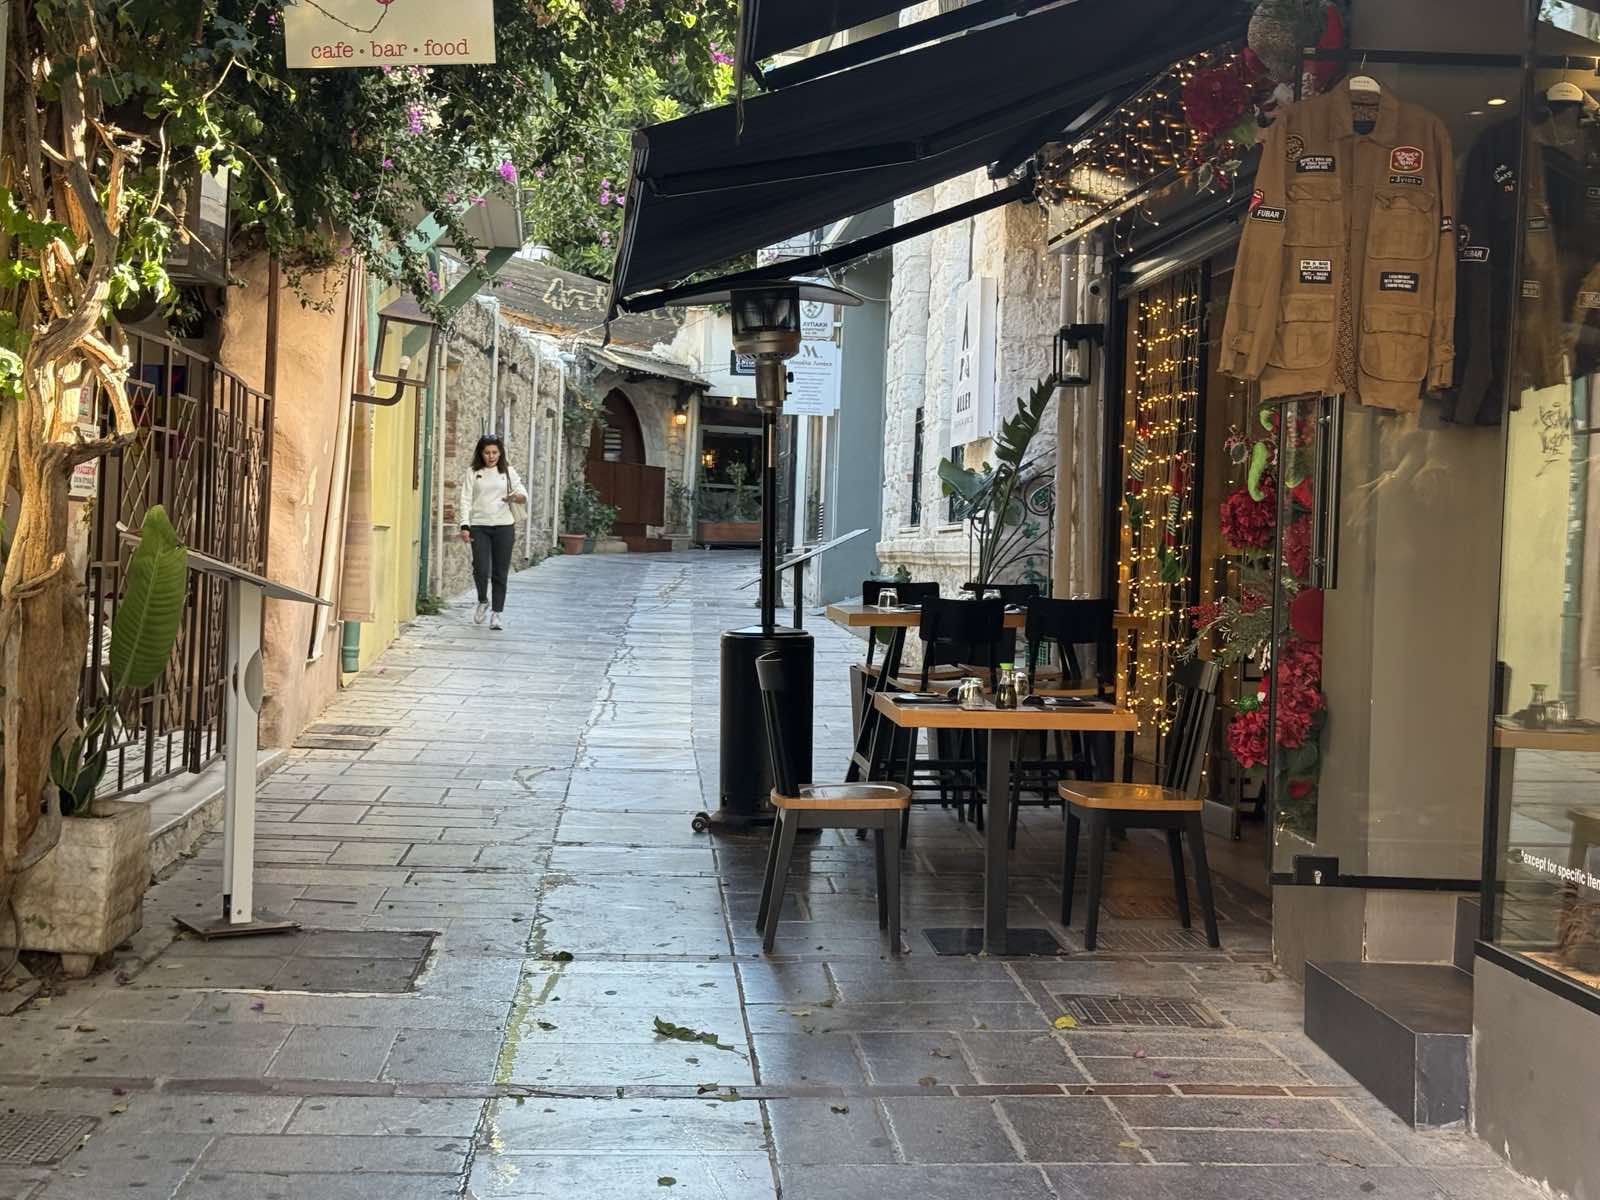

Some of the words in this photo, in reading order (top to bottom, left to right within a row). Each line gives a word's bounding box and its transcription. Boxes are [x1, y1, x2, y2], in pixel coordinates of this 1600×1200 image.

[311, 41, 354, 59] cafe
[370, 40, 408, 57] bar
[424, 38, 470, 56] food
[1256, 209, 1281, 219] FUBAR
[956, 391, 971, 414] ALLEY
[1547, 858, 1557, 874] for
[1557, 865, 1585, 885] specific
